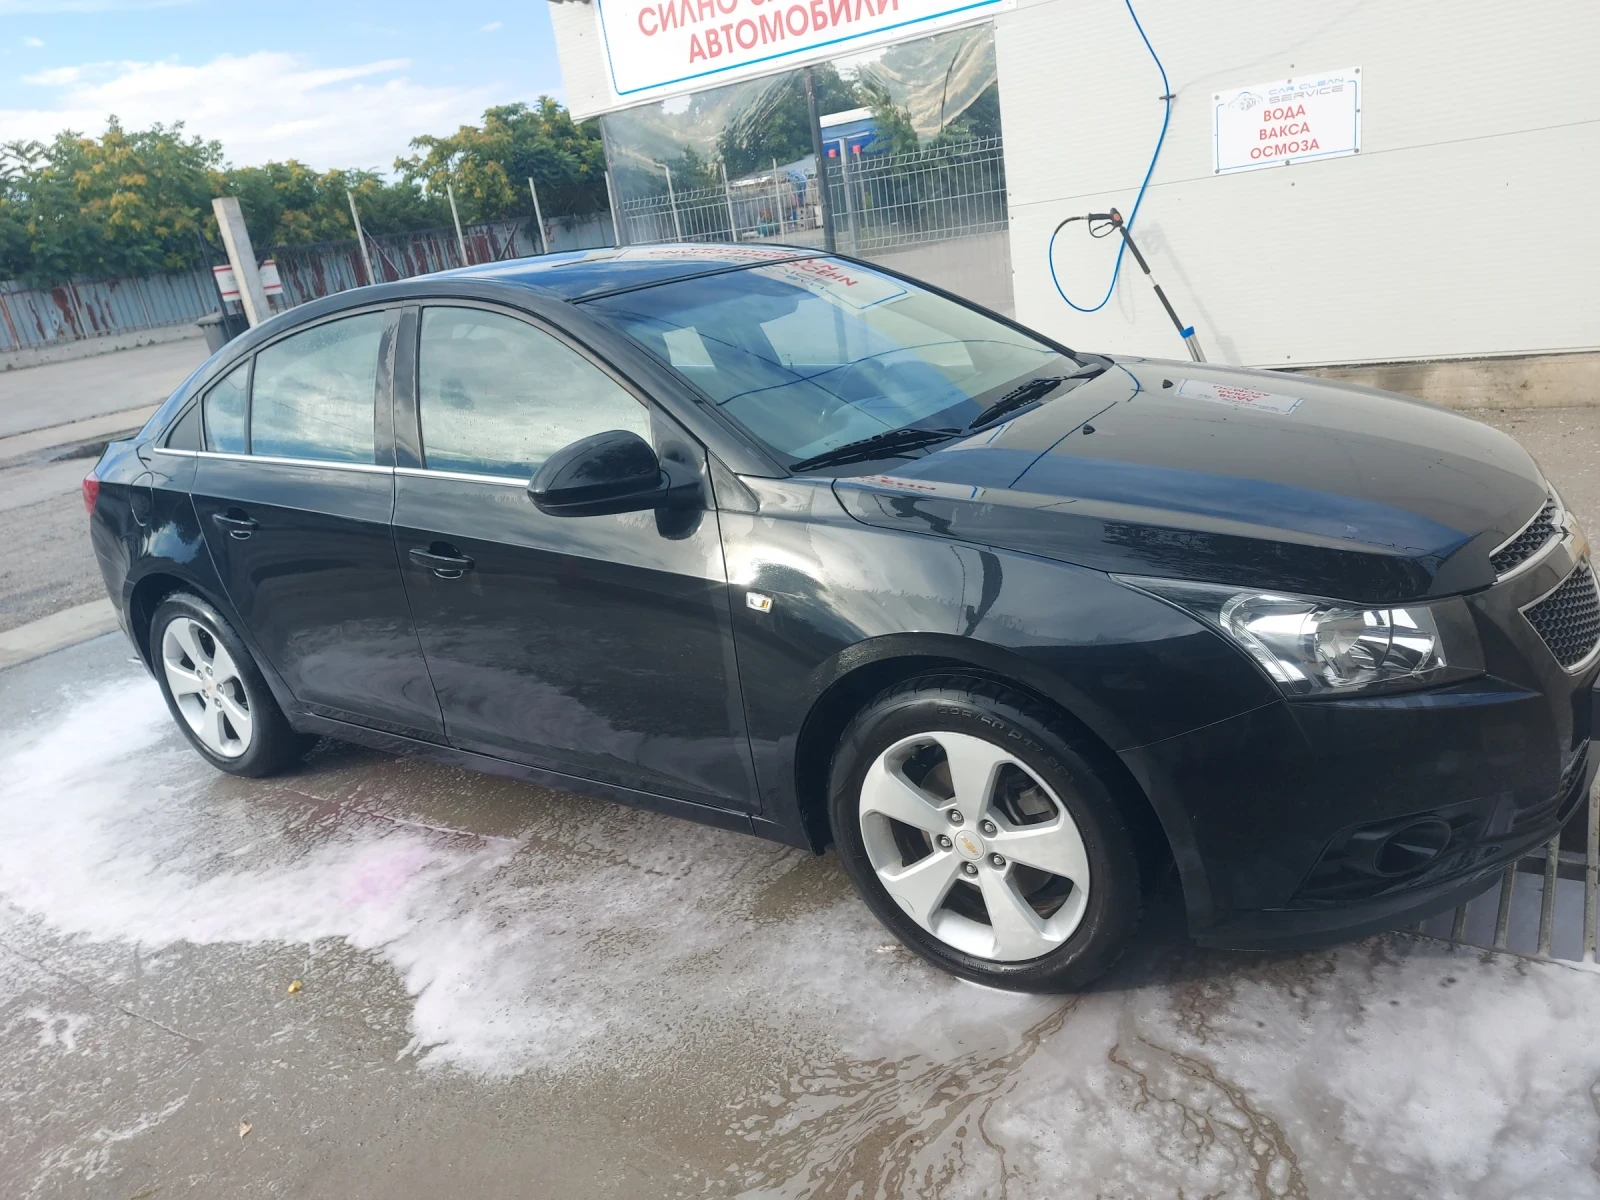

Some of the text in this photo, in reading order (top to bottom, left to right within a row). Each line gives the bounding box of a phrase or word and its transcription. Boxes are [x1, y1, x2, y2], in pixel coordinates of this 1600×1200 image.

[1269, 77, 1344, 96] CAR CLEAN
[1269, 84, 1344, 104] SERVICE
[1263, 104, 1306, 122] ВОДА
[1259, 122, 1311, 141] ВАКСА
[1250, 138, 1320, 159] ОСМОЗА
